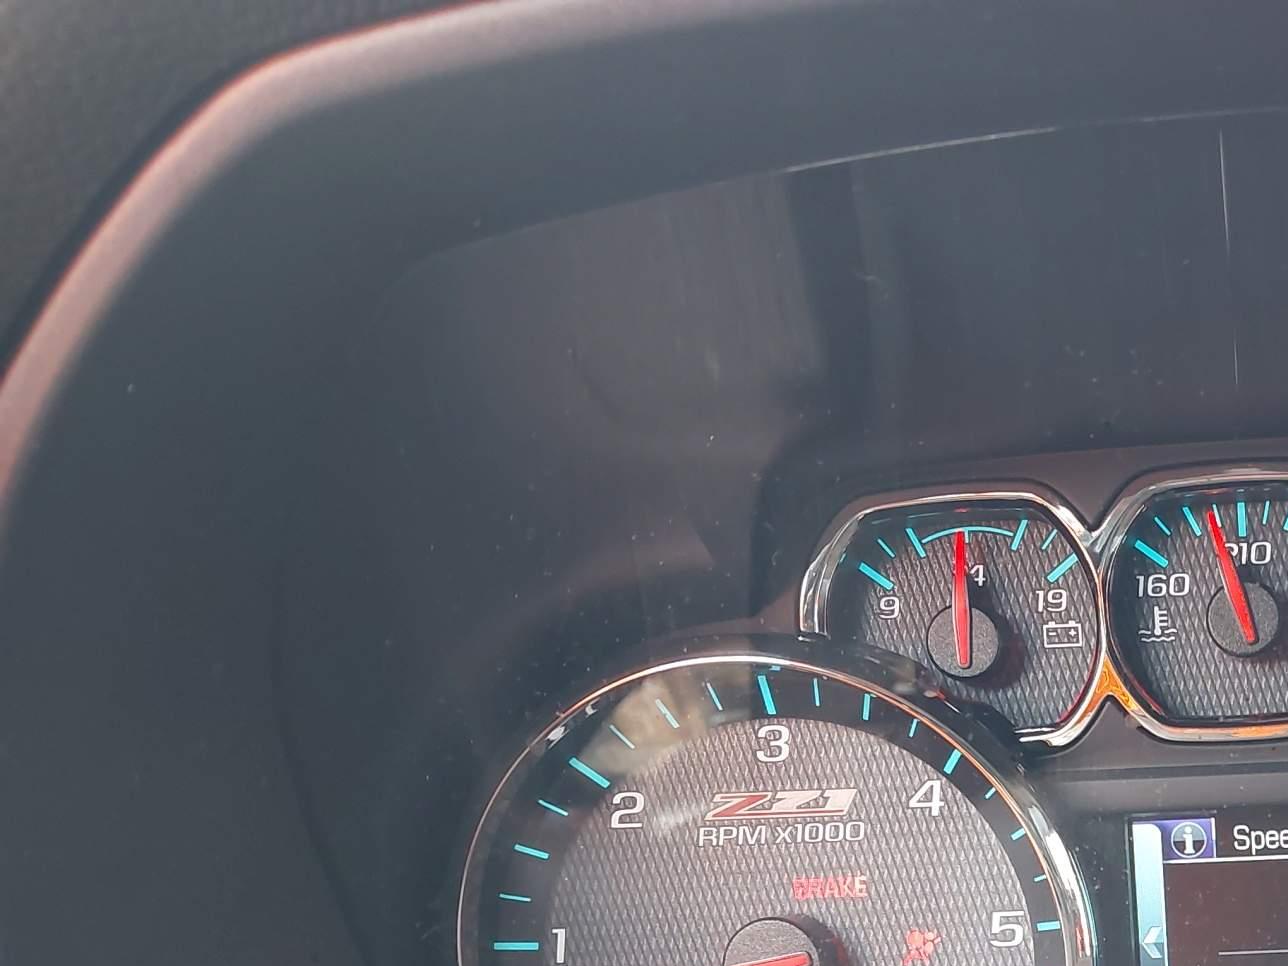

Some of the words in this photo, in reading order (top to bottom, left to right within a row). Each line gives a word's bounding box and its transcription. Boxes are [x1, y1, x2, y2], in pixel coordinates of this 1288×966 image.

[1136, 573, 1190, 597] 160
[878, 596, 899, 619] 9
[1036, 590, 1068, 613] 19
[756, 726, 789, 763] 3
[610, 793, 644, 828] 2
[908, 780, 945, 817] 4
[699, 825, 766, 847] RPM
[792, 876, 868, 899] BRAKE
[989, 911, 1025, 948] 5
[551, 928, 566, 964] 1
